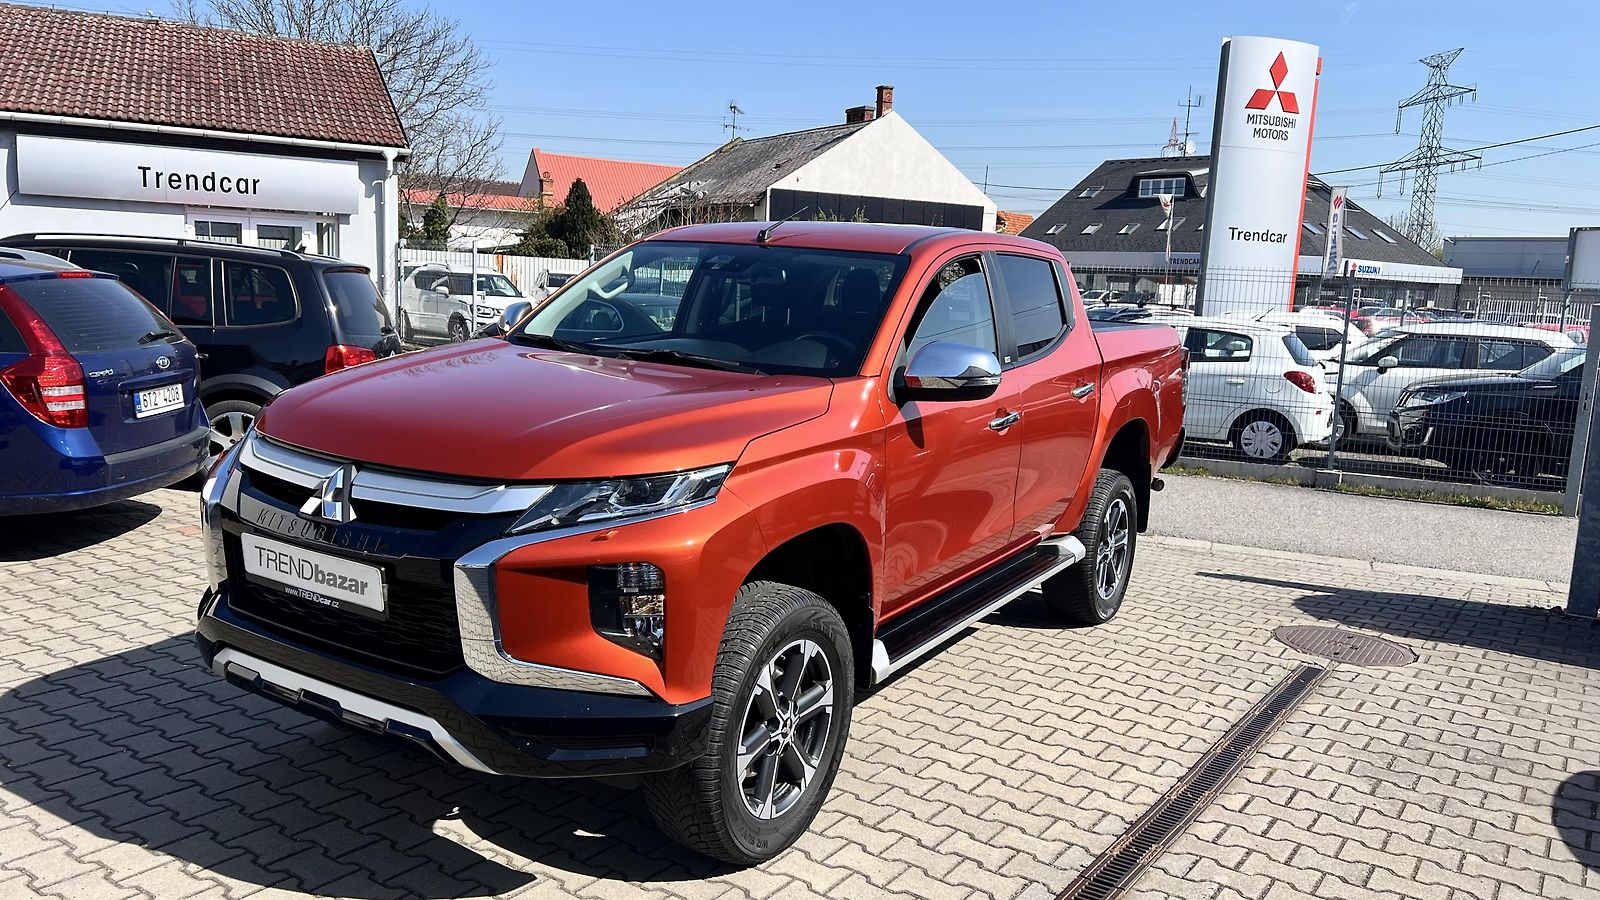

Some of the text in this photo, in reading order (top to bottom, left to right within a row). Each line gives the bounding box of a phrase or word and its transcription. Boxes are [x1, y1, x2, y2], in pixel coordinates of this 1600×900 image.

[1246, 113, 1297, 129] MITSUBISHI
[1253, 127, 1289, 141] MOTORS
[137, 165, 261, 196] Trendcar
[1228, 226, 1288, 244] Trendcar
[1357, 265, 1381, 275] SUZUKI
[142, 391, 159, 408] 6T2
[256, 508, 382, 552] MITSUBISHI
[254, 545, 368, 596] TRENDbazar
